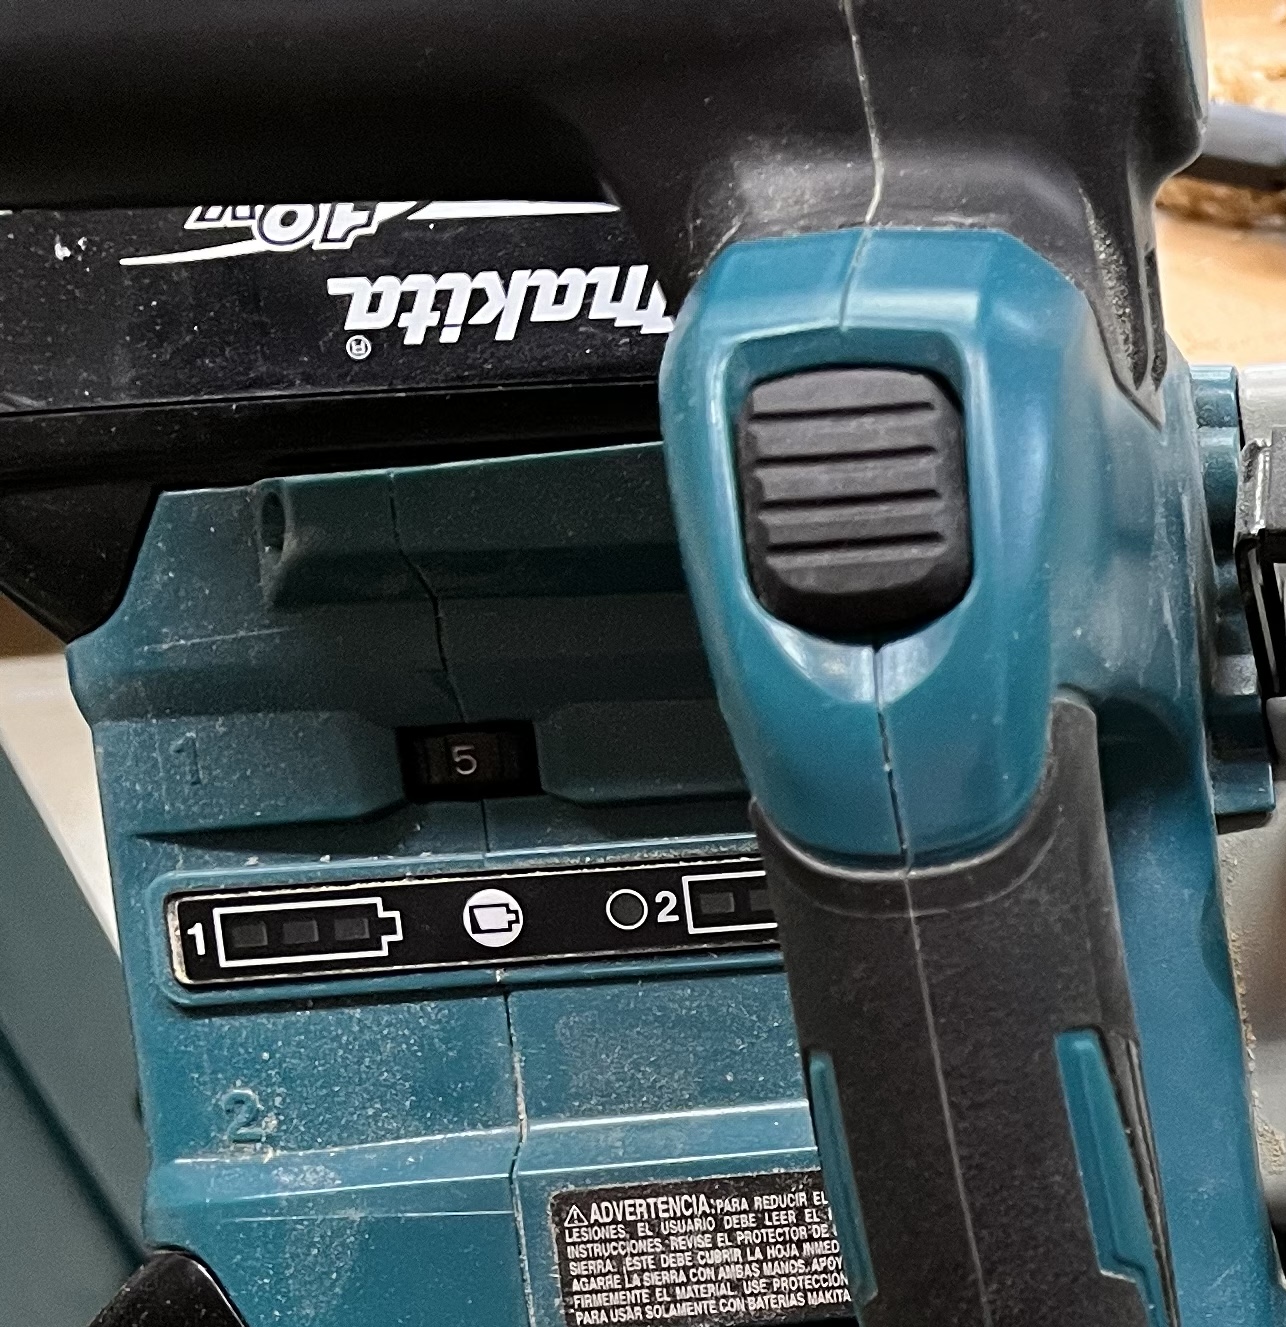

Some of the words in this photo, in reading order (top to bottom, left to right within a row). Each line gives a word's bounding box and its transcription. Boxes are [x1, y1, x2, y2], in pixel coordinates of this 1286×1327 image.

[452, 745, 477, 775] 5
[187, 922, 206, 956] 1
[655, 890, 679, 922] 2
[221, 1087, 265, 1143] 2
[590, 1193, 715, 1224] ADVERTENCIA:
[716, 1197, 749, 1214] PARA
[754, 1191, 807, 1211] REDUCIR
[812, 1191, 828, 1206] EL
[637, 1222, 653, 1237] EL
[660, 1215, 716, 1235] USUARIO
[723, 1212, 757, 1230] DEBE
[764, 1209, 796, 1226] LEER
[804, 1208, 820, 1223] EL
[669, 1233, 712, 1251] REVISE
[717, 1232, 732, 1247] EL
[736, 1225, 808, 1245] PROTECTOR
[811, 1224, 830, 1239] DE
[660, 1251, 693, 1268] DEBE
[697, 1247, 742, 1265] CUBRIR
[746, 1246, 763, 1262] LA
[766, 1243, 799, 1260] HOJA
[572, 1274, 622, 1292] AGARRE
[624, 1271, 641, 1289] LA
[643, 1268, 687, 1287] SIERRA
[689, 1266, 715, 1282] CON
[718, 1262, 760, 1281] AMBAS
[573, 1288, 650, 1309] FIRMEMENTE
[655, 1287, 671, 1302] EL
[743, 1278, 768, 1294] USE
[575, 1308, 608, 1326] PARA
[610, 1305, 643, 1323] USAR
[645, 1299, 717, 1319] SOLAMENTE
[719, 1296, 745, 1313] CON
[807, 1288, 852, 1306] MAKITA
